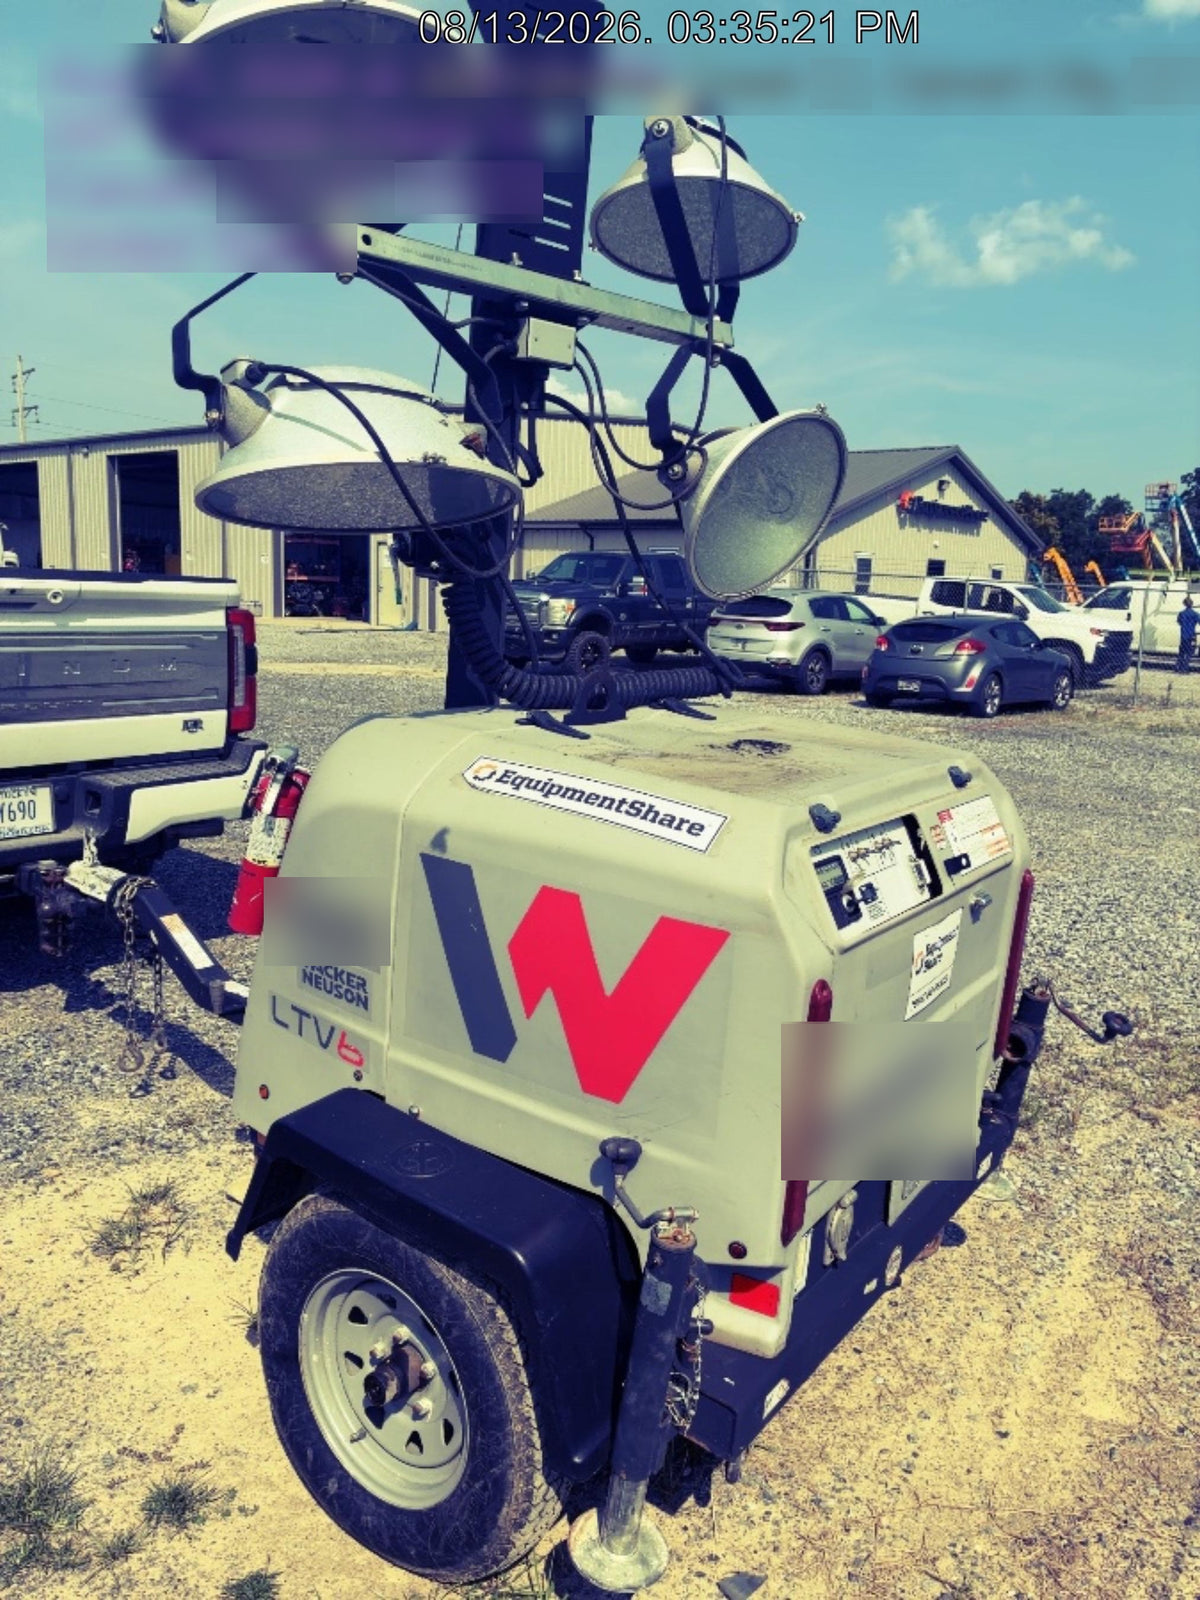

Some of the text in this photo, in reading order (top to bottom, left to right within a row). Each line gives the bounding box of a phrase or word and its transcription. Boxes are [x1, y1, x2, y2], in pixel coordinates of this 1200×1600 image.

[494, 769, 705, 837] EquipmentShare
[302, 968, 369, 1012] NEUSON
[271, 994, 365, 1068] LTV6
